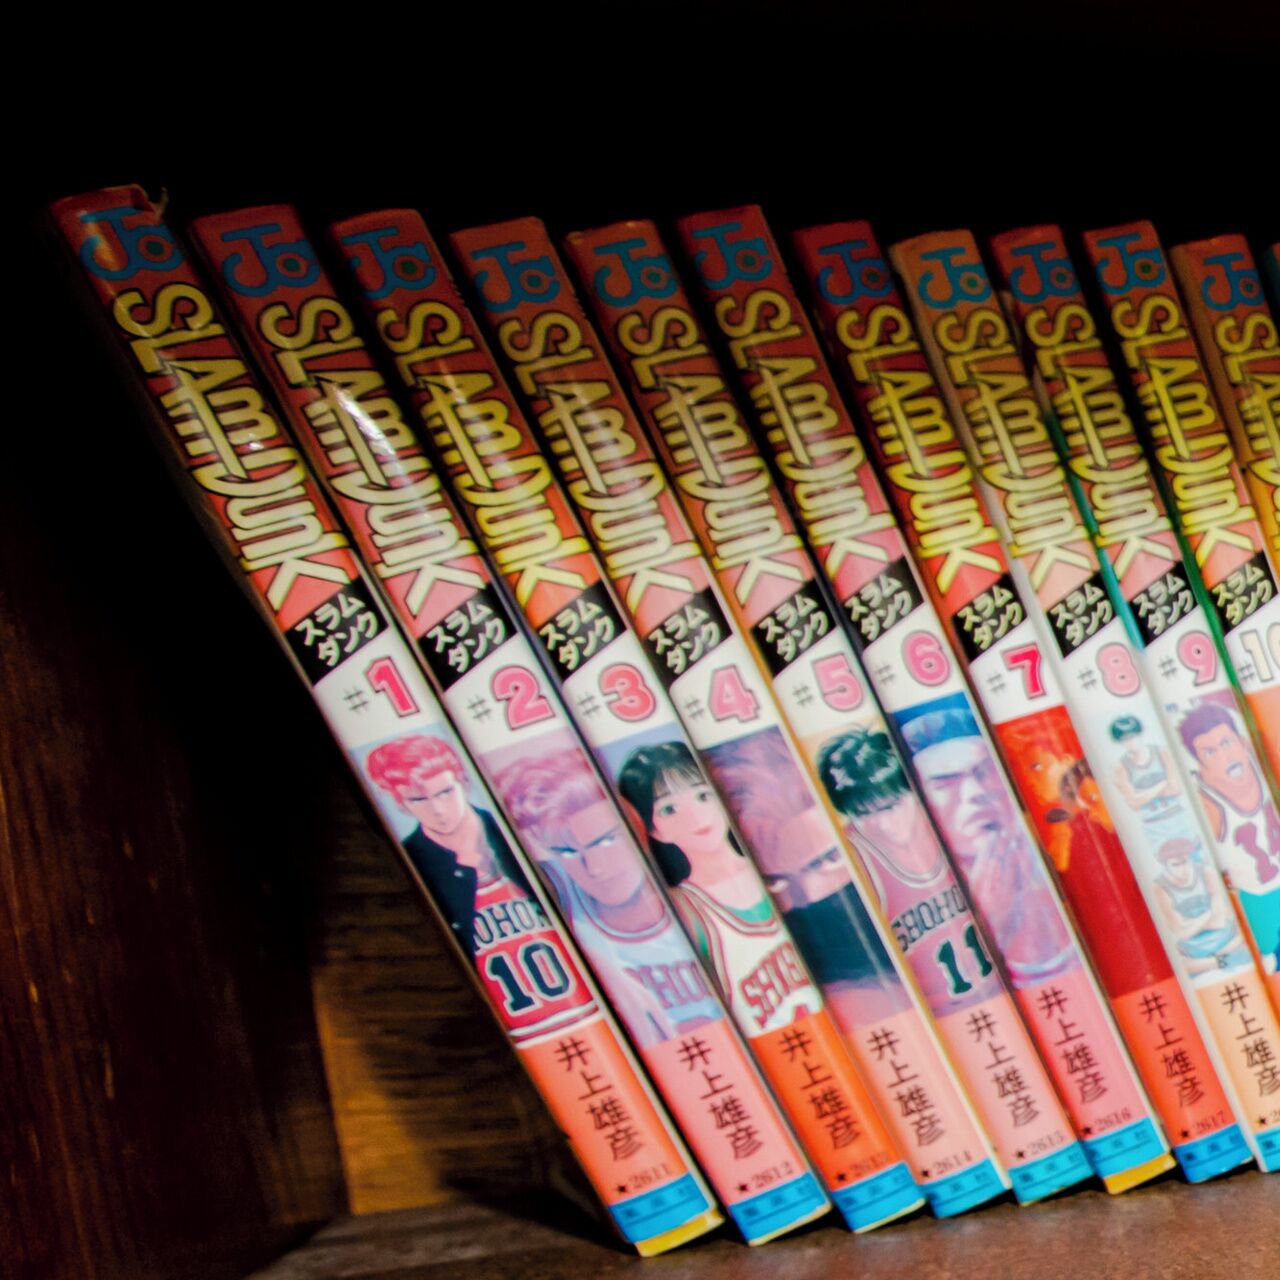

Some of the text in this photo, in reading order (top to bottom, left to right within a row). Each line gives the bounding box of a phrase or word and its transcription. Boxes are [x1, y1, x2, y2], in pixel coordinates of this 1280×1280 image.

[555, 1033, 640, 1161] 井上雄彦
[676, 1036, 765, 1160] 井上雄彦
[780, 1029, 862, 1148] 井上雄彦
[869, 1029, 946, 1147] 井上雄彦
[966, 1009, 1039, 1127] 井上雄彦
[1037, 988, 1108, 1107] 井上雄彦
[1140, 991, 1204, 1108] 井上雄彦
